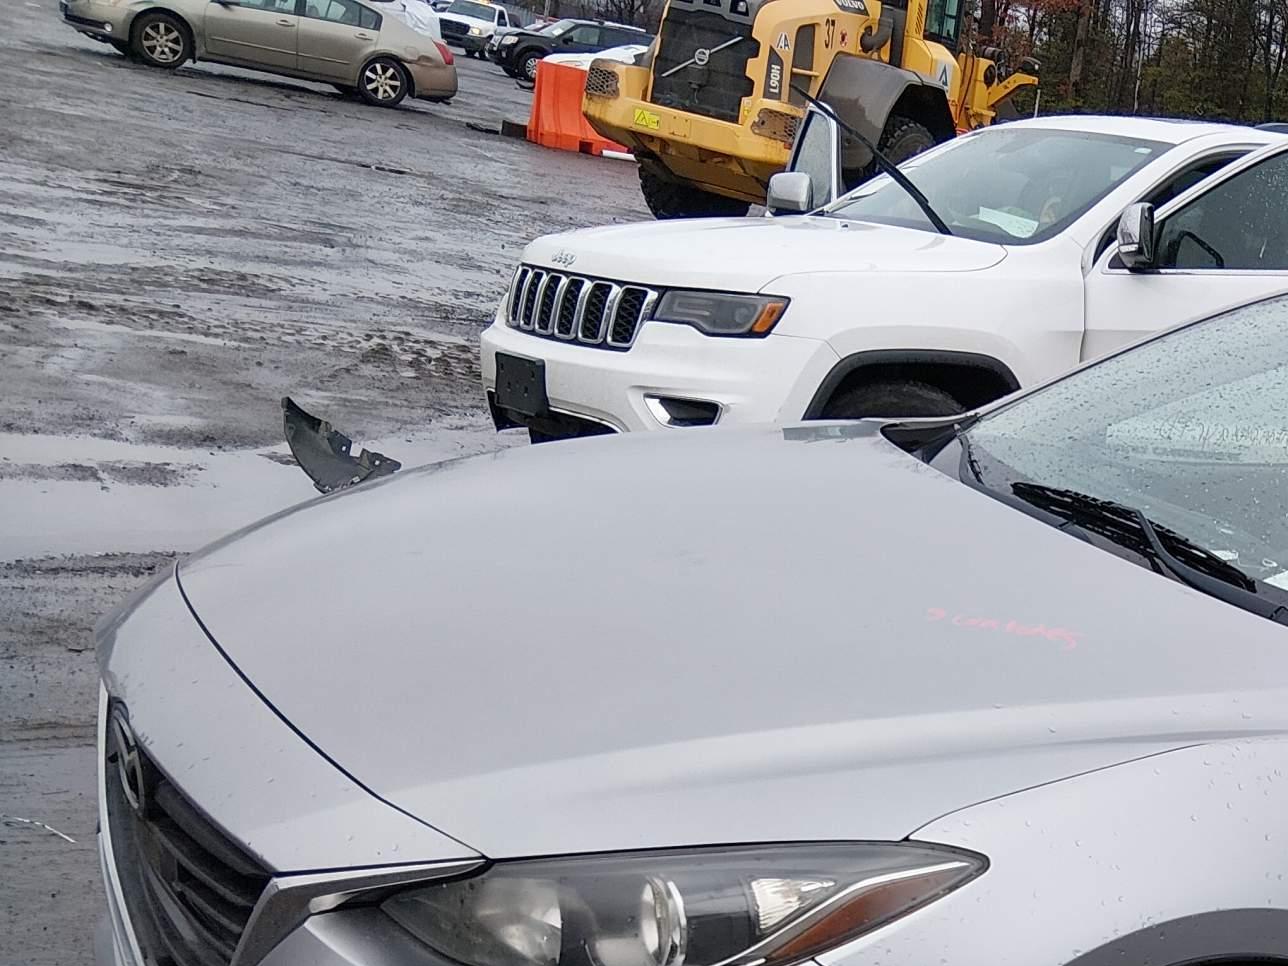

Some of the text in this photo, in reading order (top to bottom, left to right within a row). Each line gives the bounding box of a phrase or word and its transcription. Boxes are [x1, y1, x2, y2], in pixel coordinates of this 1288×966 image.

[835, 0, 865, 11] VOLVO
[824, 17, 837, 50] 37
[768, 64, 782, 94] L90H
